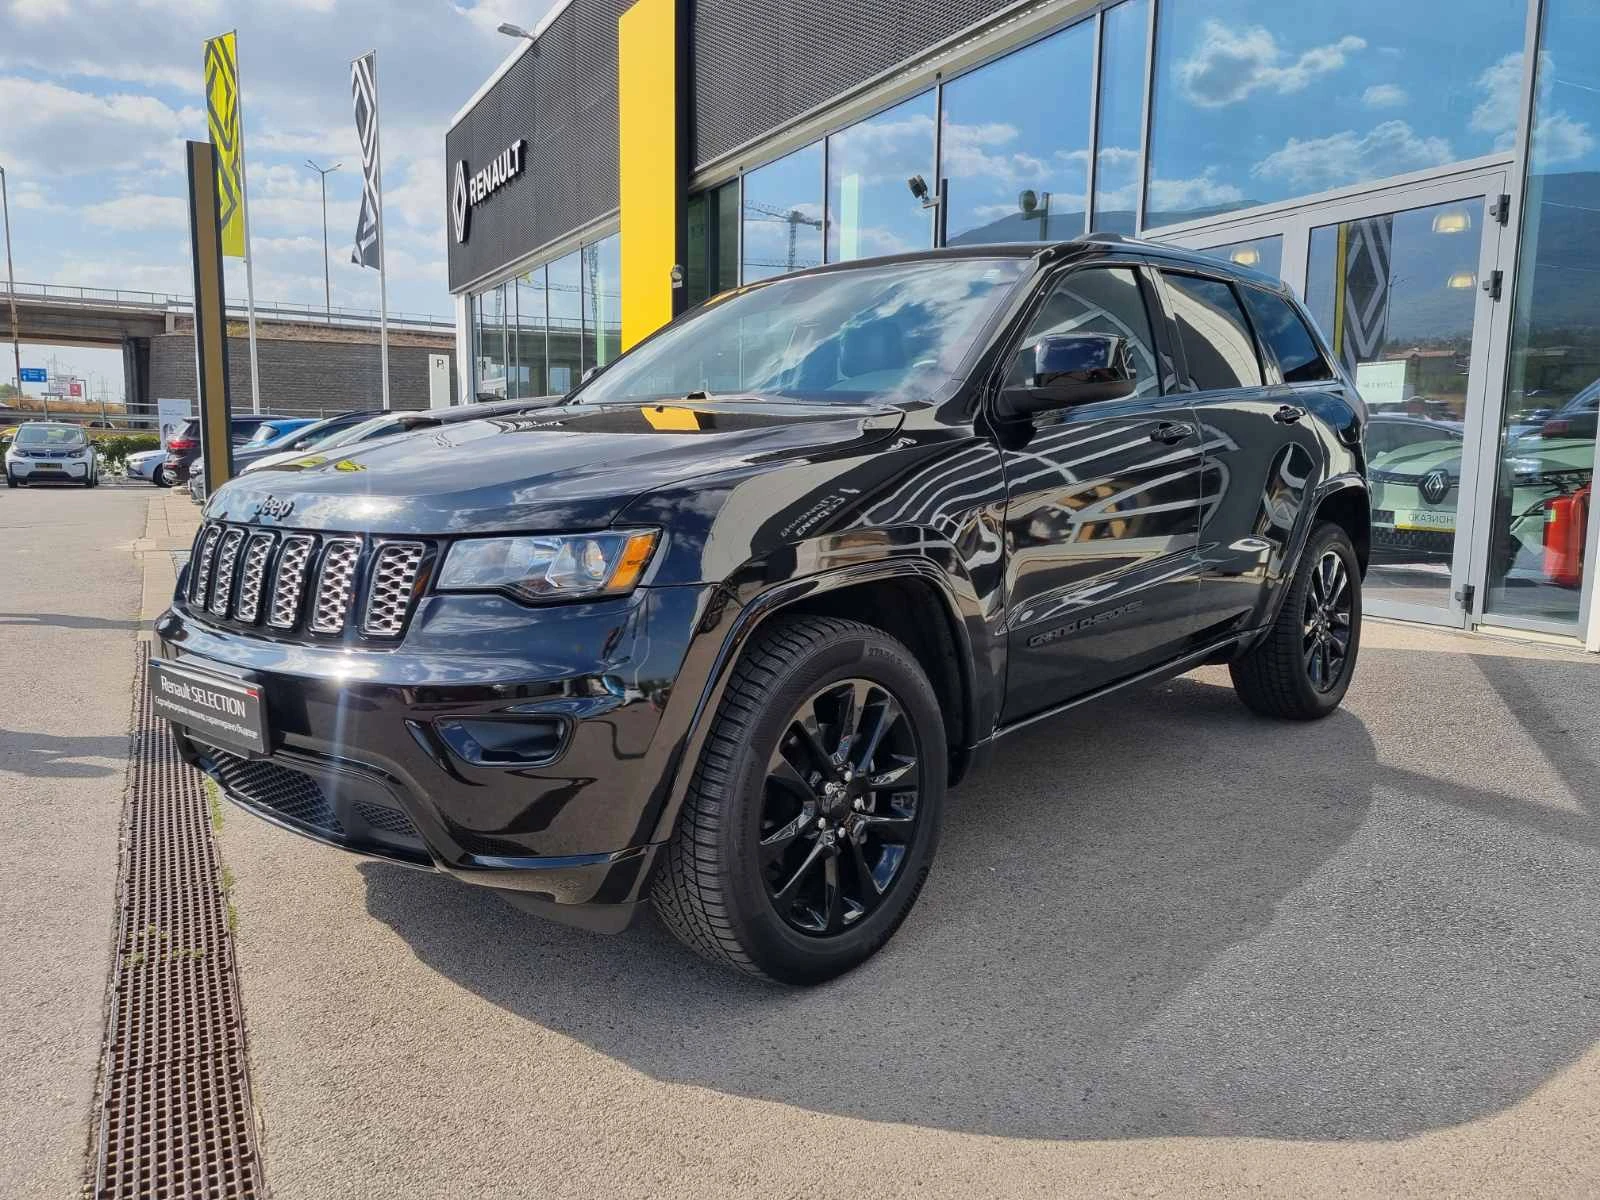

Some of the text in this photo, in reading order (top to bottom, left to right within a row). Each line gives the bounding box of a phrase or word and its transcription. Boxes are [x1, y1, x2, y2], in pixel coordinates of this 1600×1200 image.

[469, 139, 521, 207] RENAULT
[255, 495, 295, 521] Jeep
[161, 675, 191, 700] Renault
[191, 687, 246, 718] SELECTION
